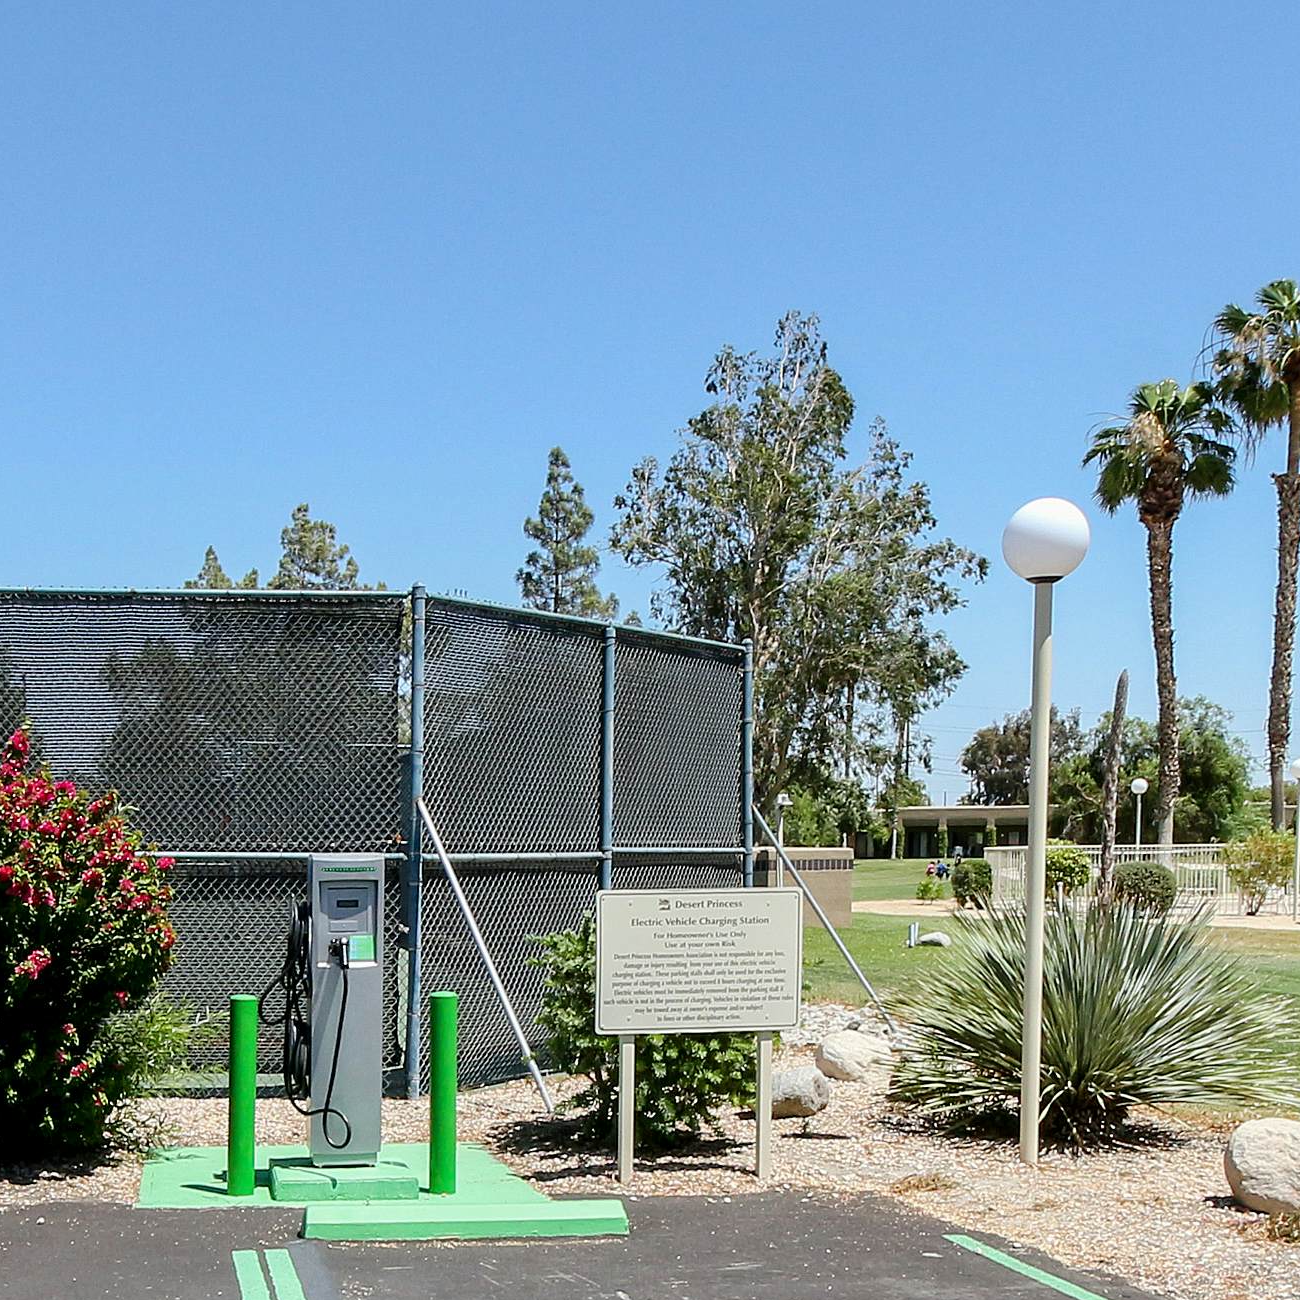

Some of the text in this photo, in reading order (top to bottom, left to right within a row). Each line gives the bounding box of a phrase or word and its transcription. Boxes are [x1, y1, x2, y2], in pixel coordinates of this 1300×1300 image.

[676, 899, 743, 908] Desert Princess
[631, 916, 770, 927] Electric Vehicle Charging Station
[730, 930, 746, 939] Only
[688, 942, 704, 950] your
